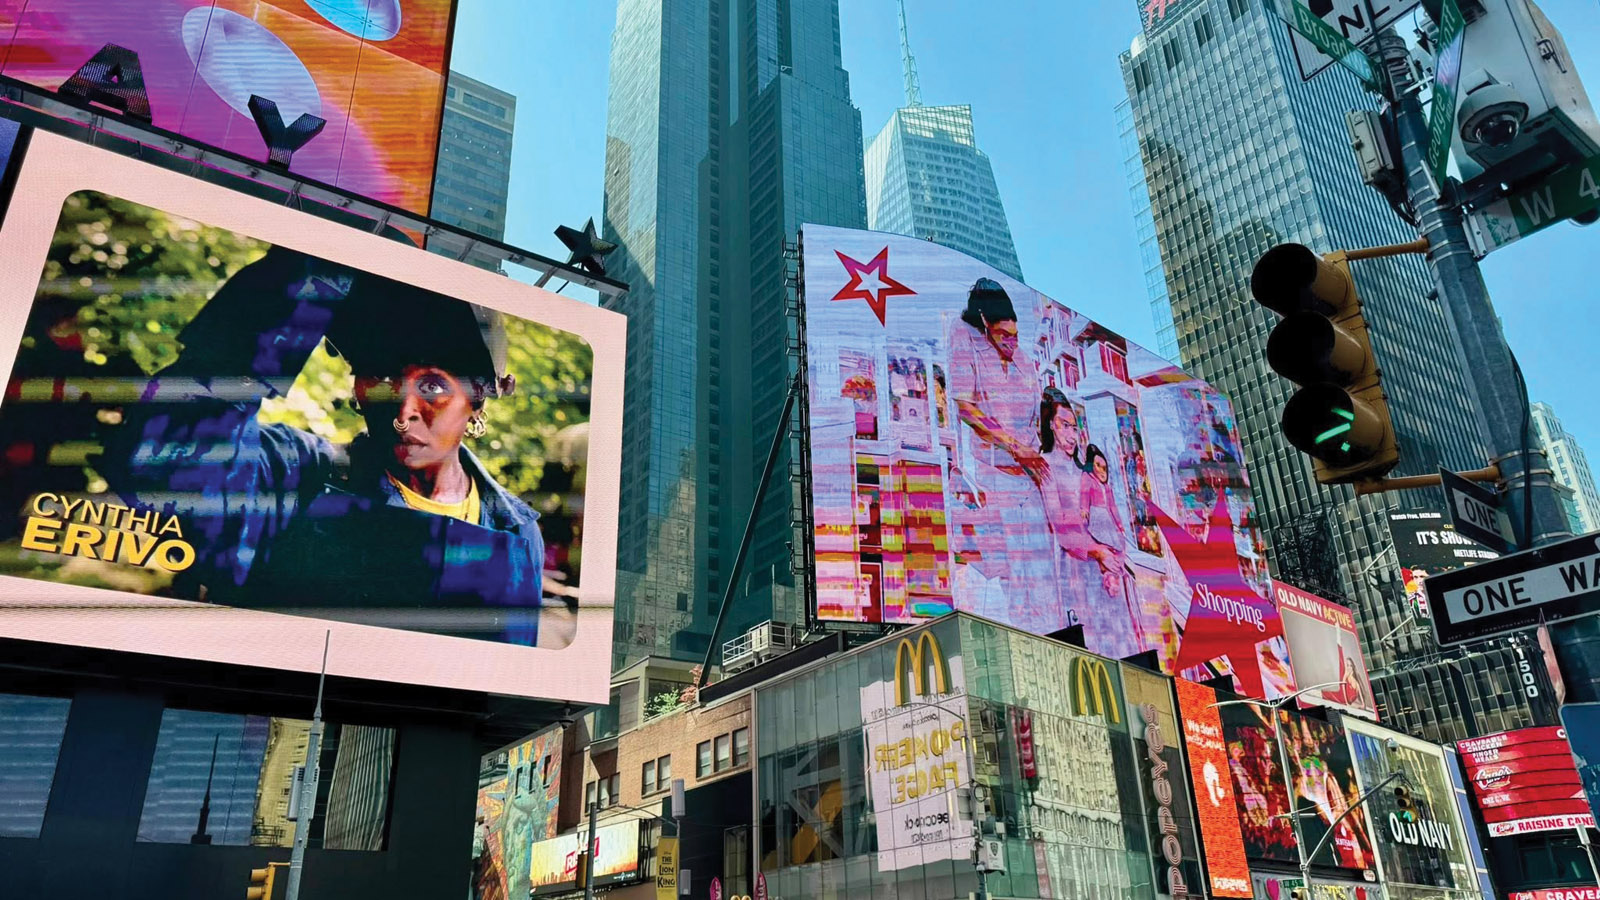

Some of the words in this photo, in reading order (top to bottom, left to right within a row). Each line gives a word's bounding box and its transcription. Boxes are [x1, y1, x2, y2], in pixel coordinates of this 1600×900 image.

[1428, 94, 1446, 168] George
[1520, 185, 1556, 226] W
[33, 492, 183, 538] CYNTHIA
[1464, 497, 1501, 535] ONE
[21, 516, 196, 572] ERIVO
[1416, 531, 1439, 545] IT'S
[1195, 582, 1266, 632] Shopping
[1277, 588, 1297, 607] OLD
[1299, 596, 1323, 618] NAVY
[1323, 606, 1353, 629] ACTIVE
[1463, 577, 1531, 615] ONE
[1389, 812, 1418, 845] OLD
[1418, 818, 1453, 851] NAVY
[1518, 818, 1563, 832] RAISING
[658, 876, 675, 888] KING
[659, 865, 674, 875] LION
